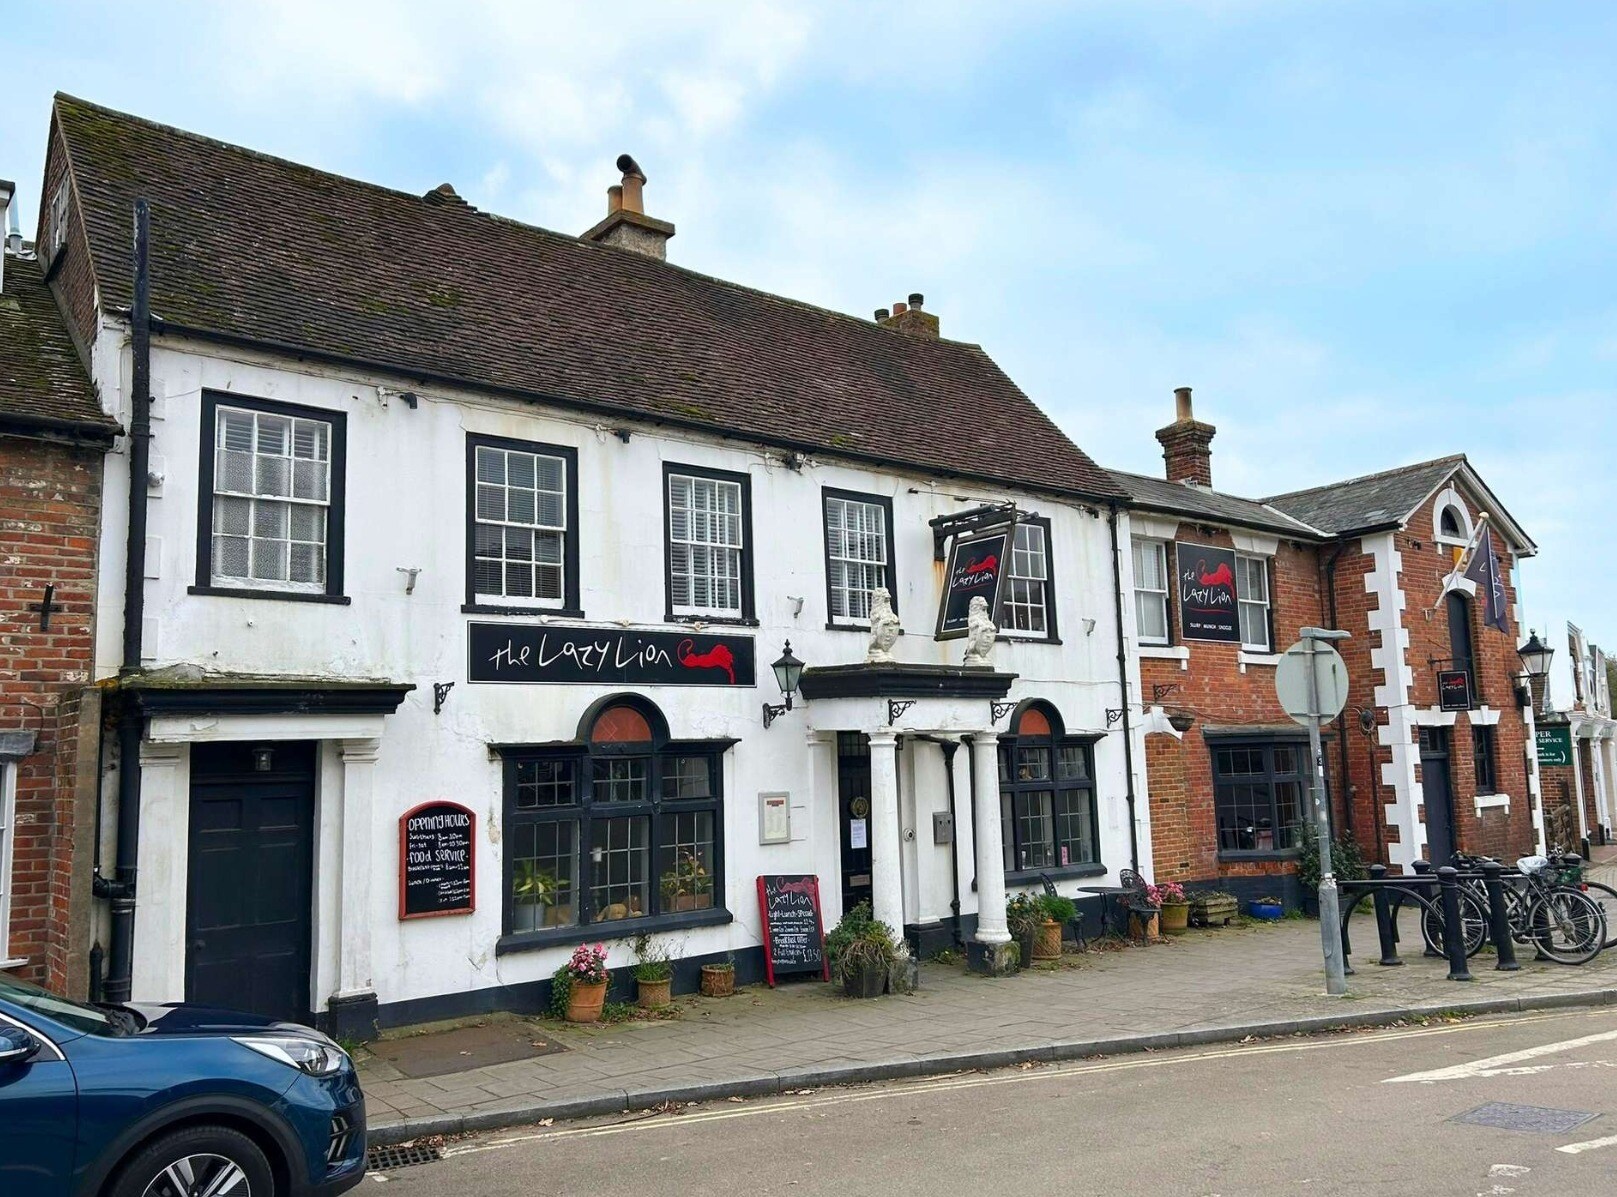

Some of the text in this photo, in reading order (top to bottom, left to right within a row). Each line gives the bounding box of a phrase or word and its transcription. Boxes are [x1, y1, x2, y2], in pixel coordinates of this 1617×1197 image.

[1183, 583, 1233, 606] Lazy Lion
[488, 633, 673, 672] the Lazy Lion
